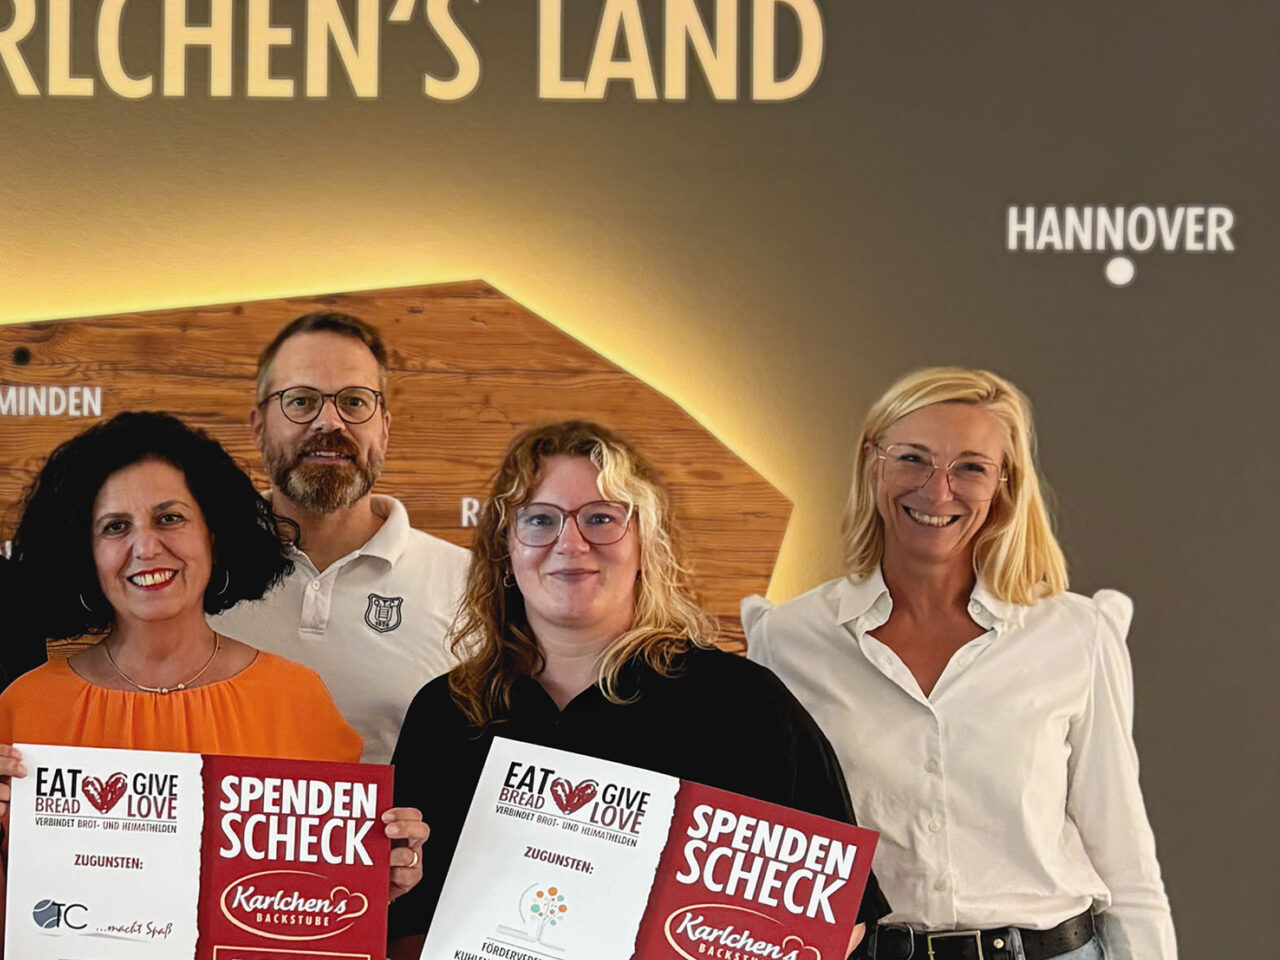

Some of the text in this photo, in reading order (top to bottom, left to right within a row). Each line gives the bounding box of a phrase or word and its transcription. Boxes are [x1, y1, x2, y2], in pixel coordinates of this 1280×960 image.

[538, 0, 824, 101] LAND
[1007, 206, 1236, 251] HANNOVER
[36, 766, 179, 799] EAT GIVE
[219, 775, 378, 819] SPENDEN
[503, 761, 651, 813] EAT GIVE
[35, 794, 178, 820] BREAD LOVE
[35, 816, 177, 833] VERBINDET BROT- UND HEIMATHELDEN
[495, 804, 638, 848] VERBINDET BROT- UND HEIMATHELDEN
[498, 787, 646, 835] BREAD LOVE
[219, 812, 375, 866] SCHECK
[523, 846, 595, 875] ZUGUNSTEN:
[686, 804, 858, 880] SPENDEN
[74, 854, 144, 870] ZUGUNSTEN:
[675, 839, 848, 925] SCHECK
[146, 921, 173, 939] Spaß
[256, 912, 330, 926] BACKSTUBE
